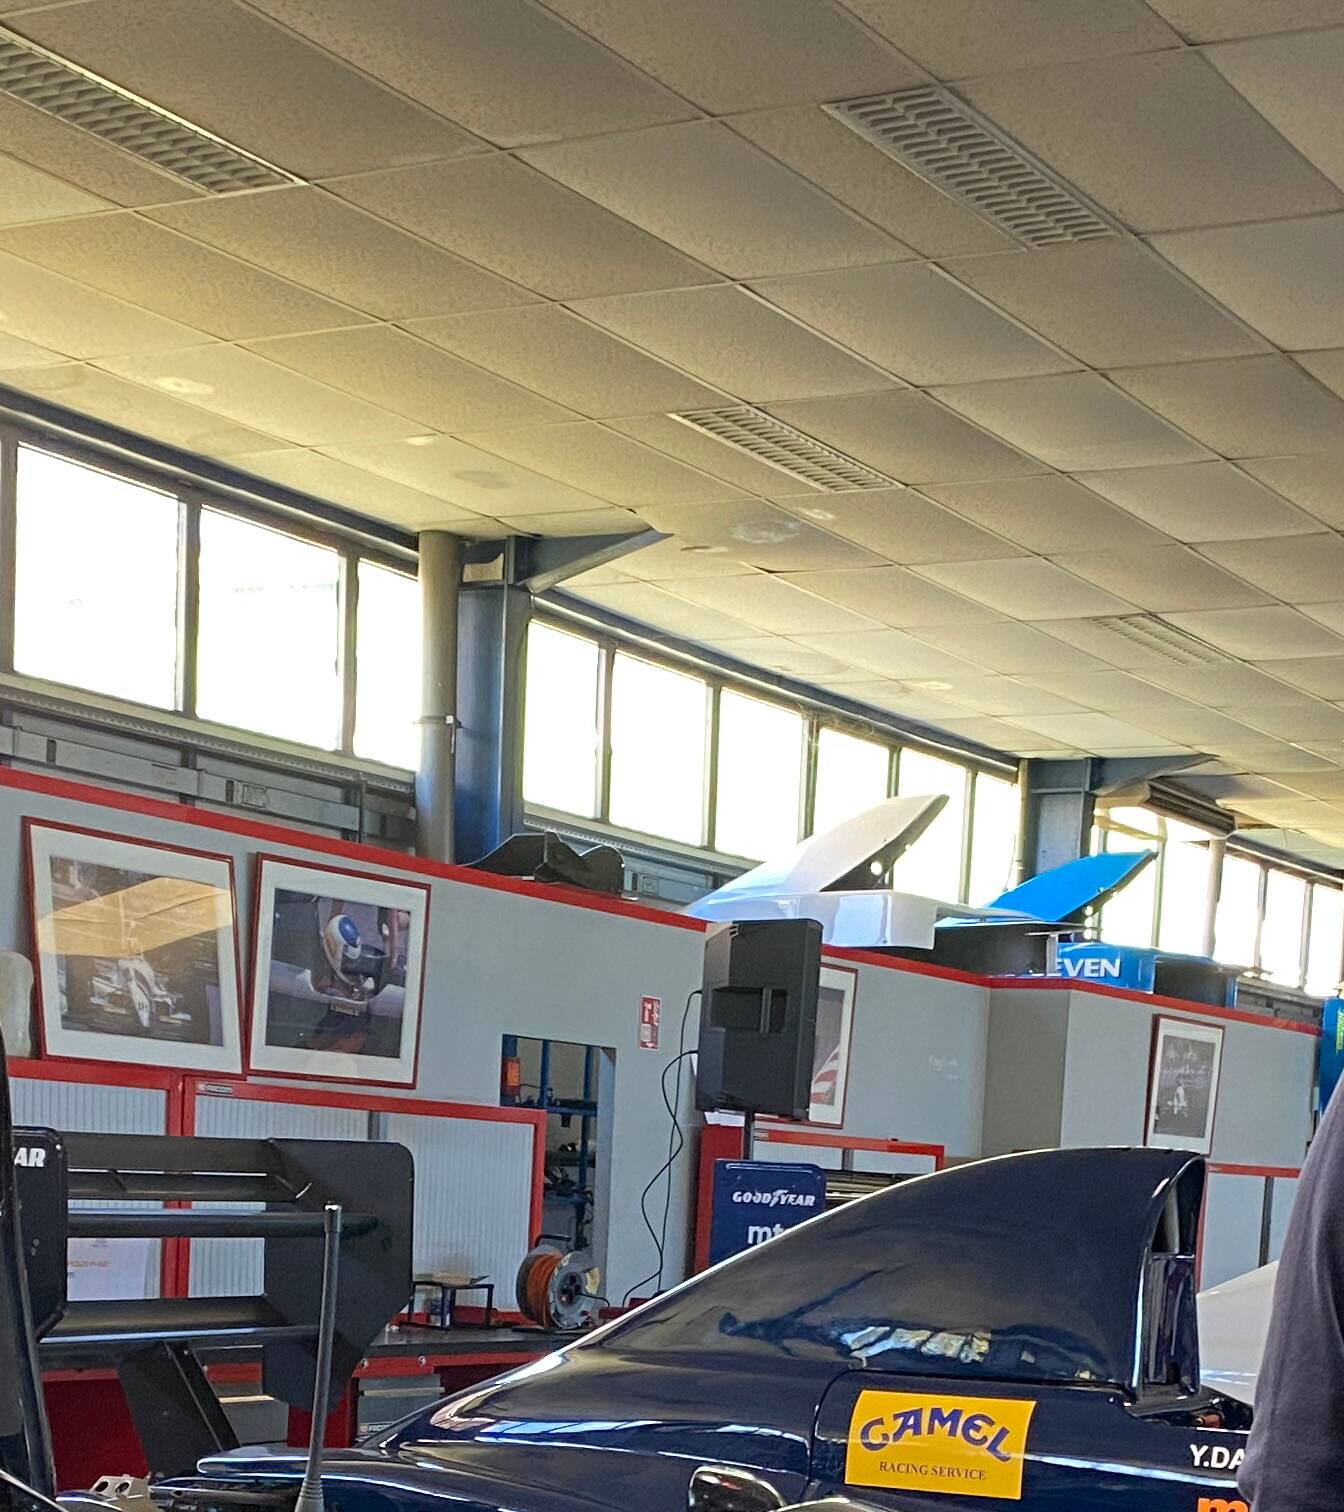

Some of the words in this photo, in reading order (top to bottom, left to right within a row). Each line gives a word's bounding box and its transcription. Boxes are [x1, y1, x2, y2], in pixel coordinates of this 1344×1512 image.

[732, 1189, 816, 1208] GOODYEAR
[859, 1407, 1012, 1463] CAMEL
[879, 1460, 929, 1477] RACING
[930, 1465, 987, 1482] SERVICE
